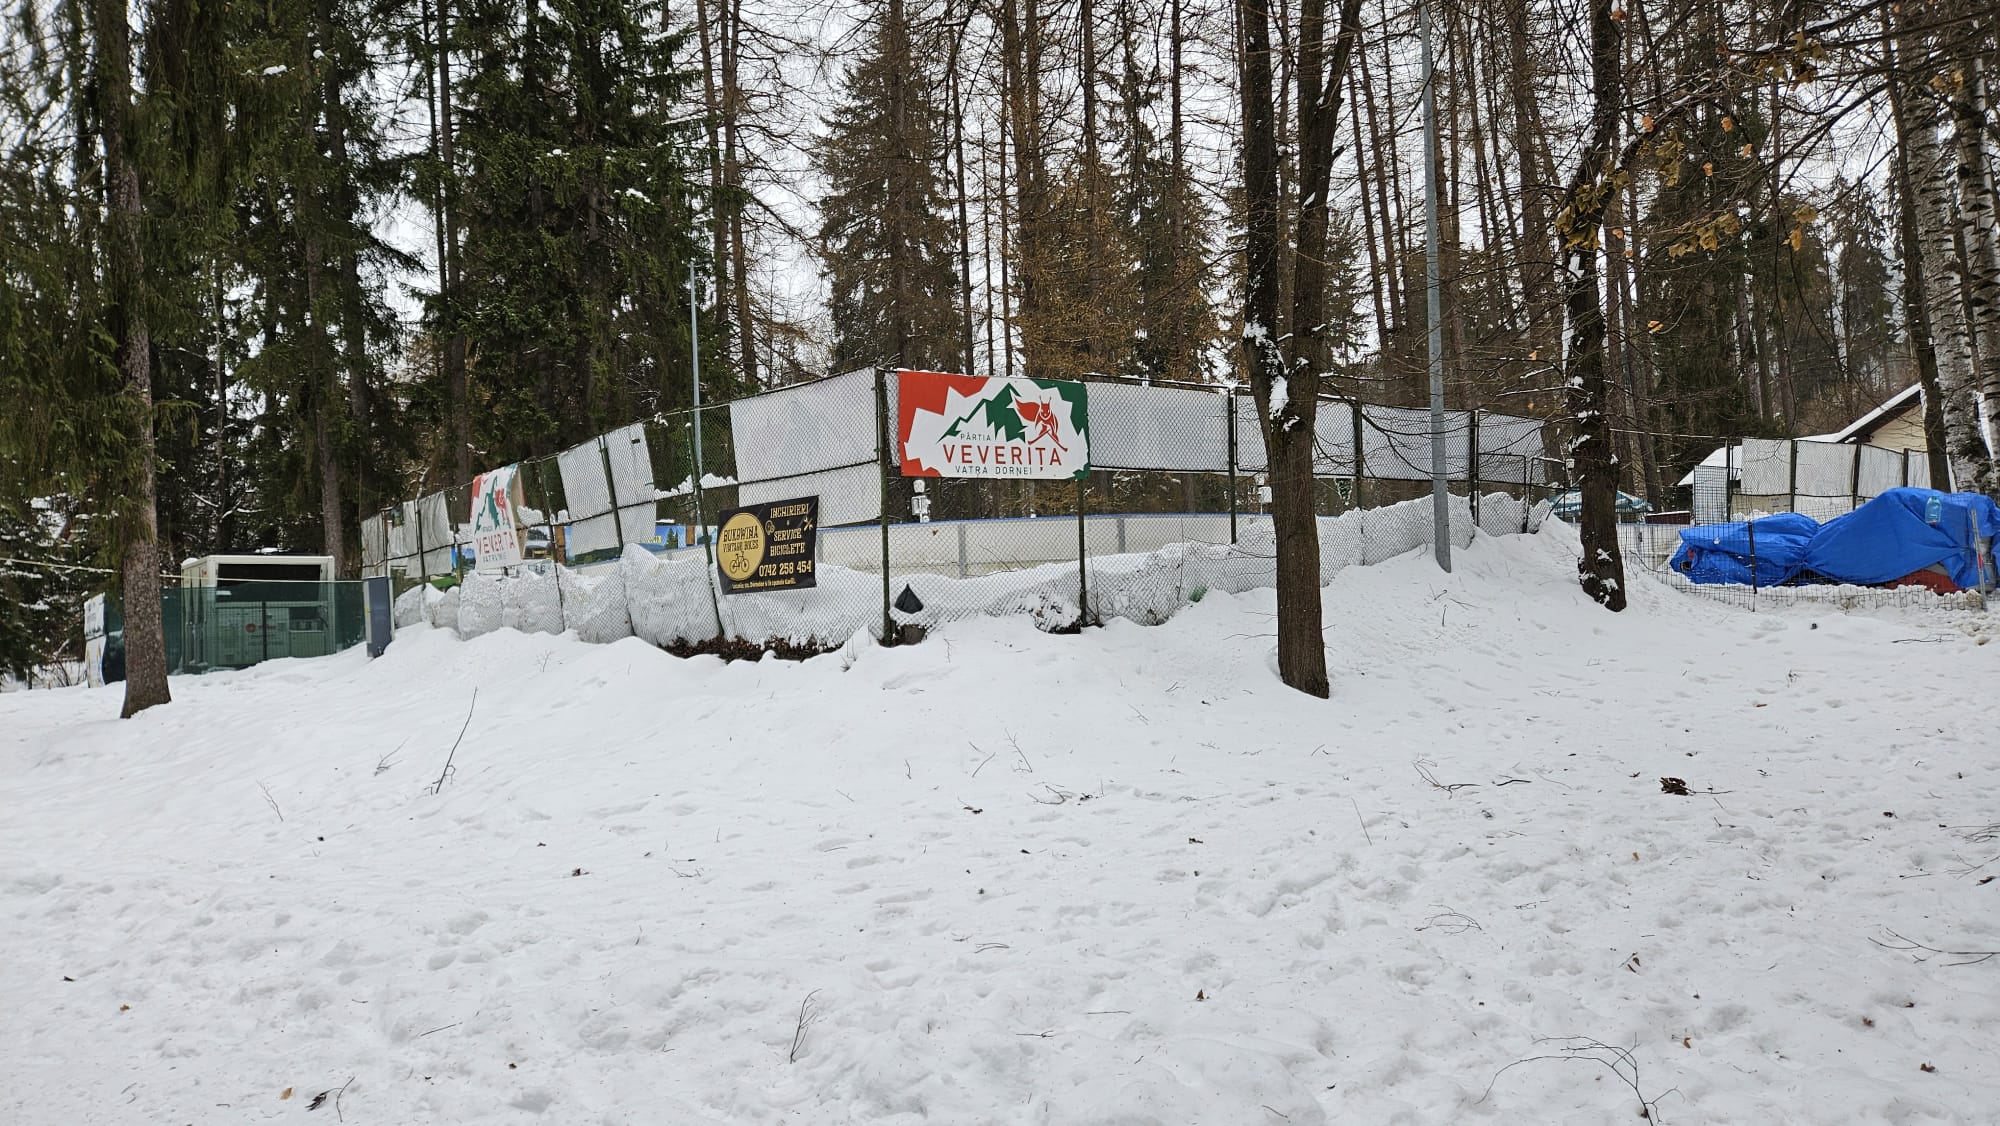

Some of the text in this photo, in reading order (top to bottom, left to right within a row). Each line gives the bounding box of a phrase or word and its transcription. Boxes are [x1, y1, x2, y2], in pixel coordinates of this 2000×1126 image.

[943, 444, 1062, 471] VEVERIȚA
[955, 466, 1033, 475] VATRA DORNEI
[774, 528, 801, 541] SERVICE
[770, 542, 805, 557] BICICLETE
[759, 560, 812, 577] 0742 258 454
